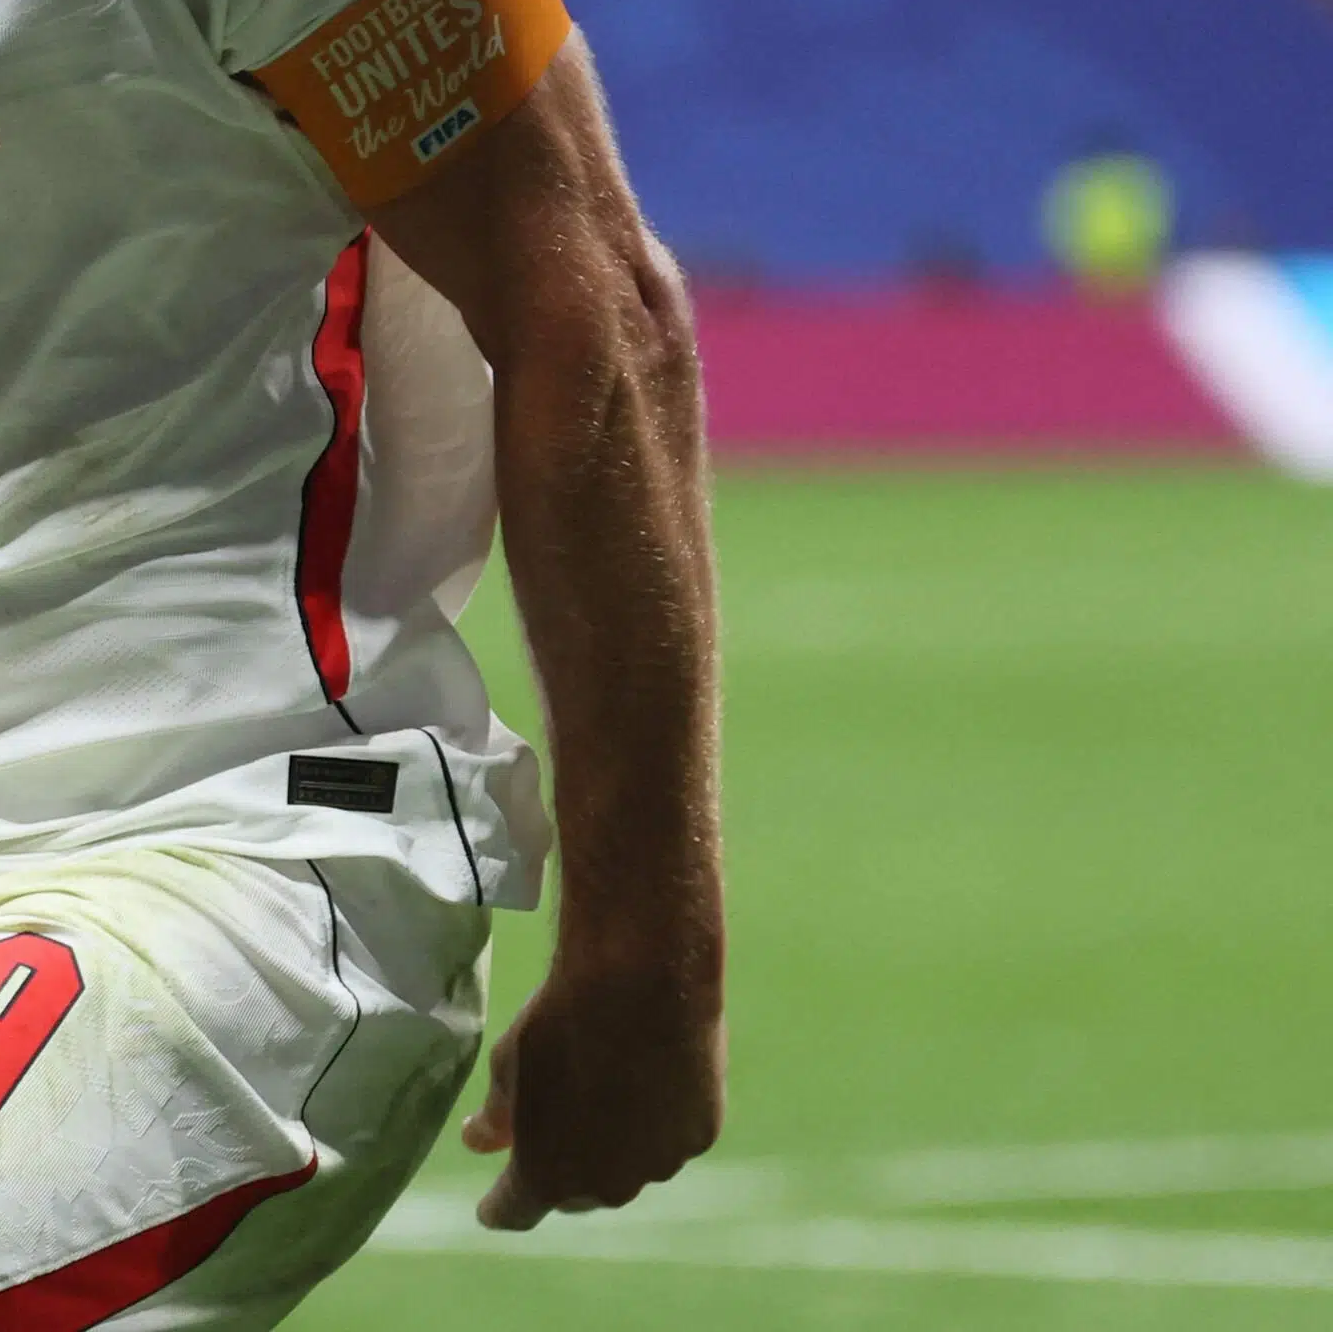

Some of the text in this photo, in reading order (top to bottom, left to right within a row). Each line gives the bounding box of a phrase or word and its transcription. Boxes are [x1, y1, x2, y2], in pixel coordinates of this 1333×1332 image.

[343, 14, 505, 159] the World
[418, 108, 477, 156] FIFA
